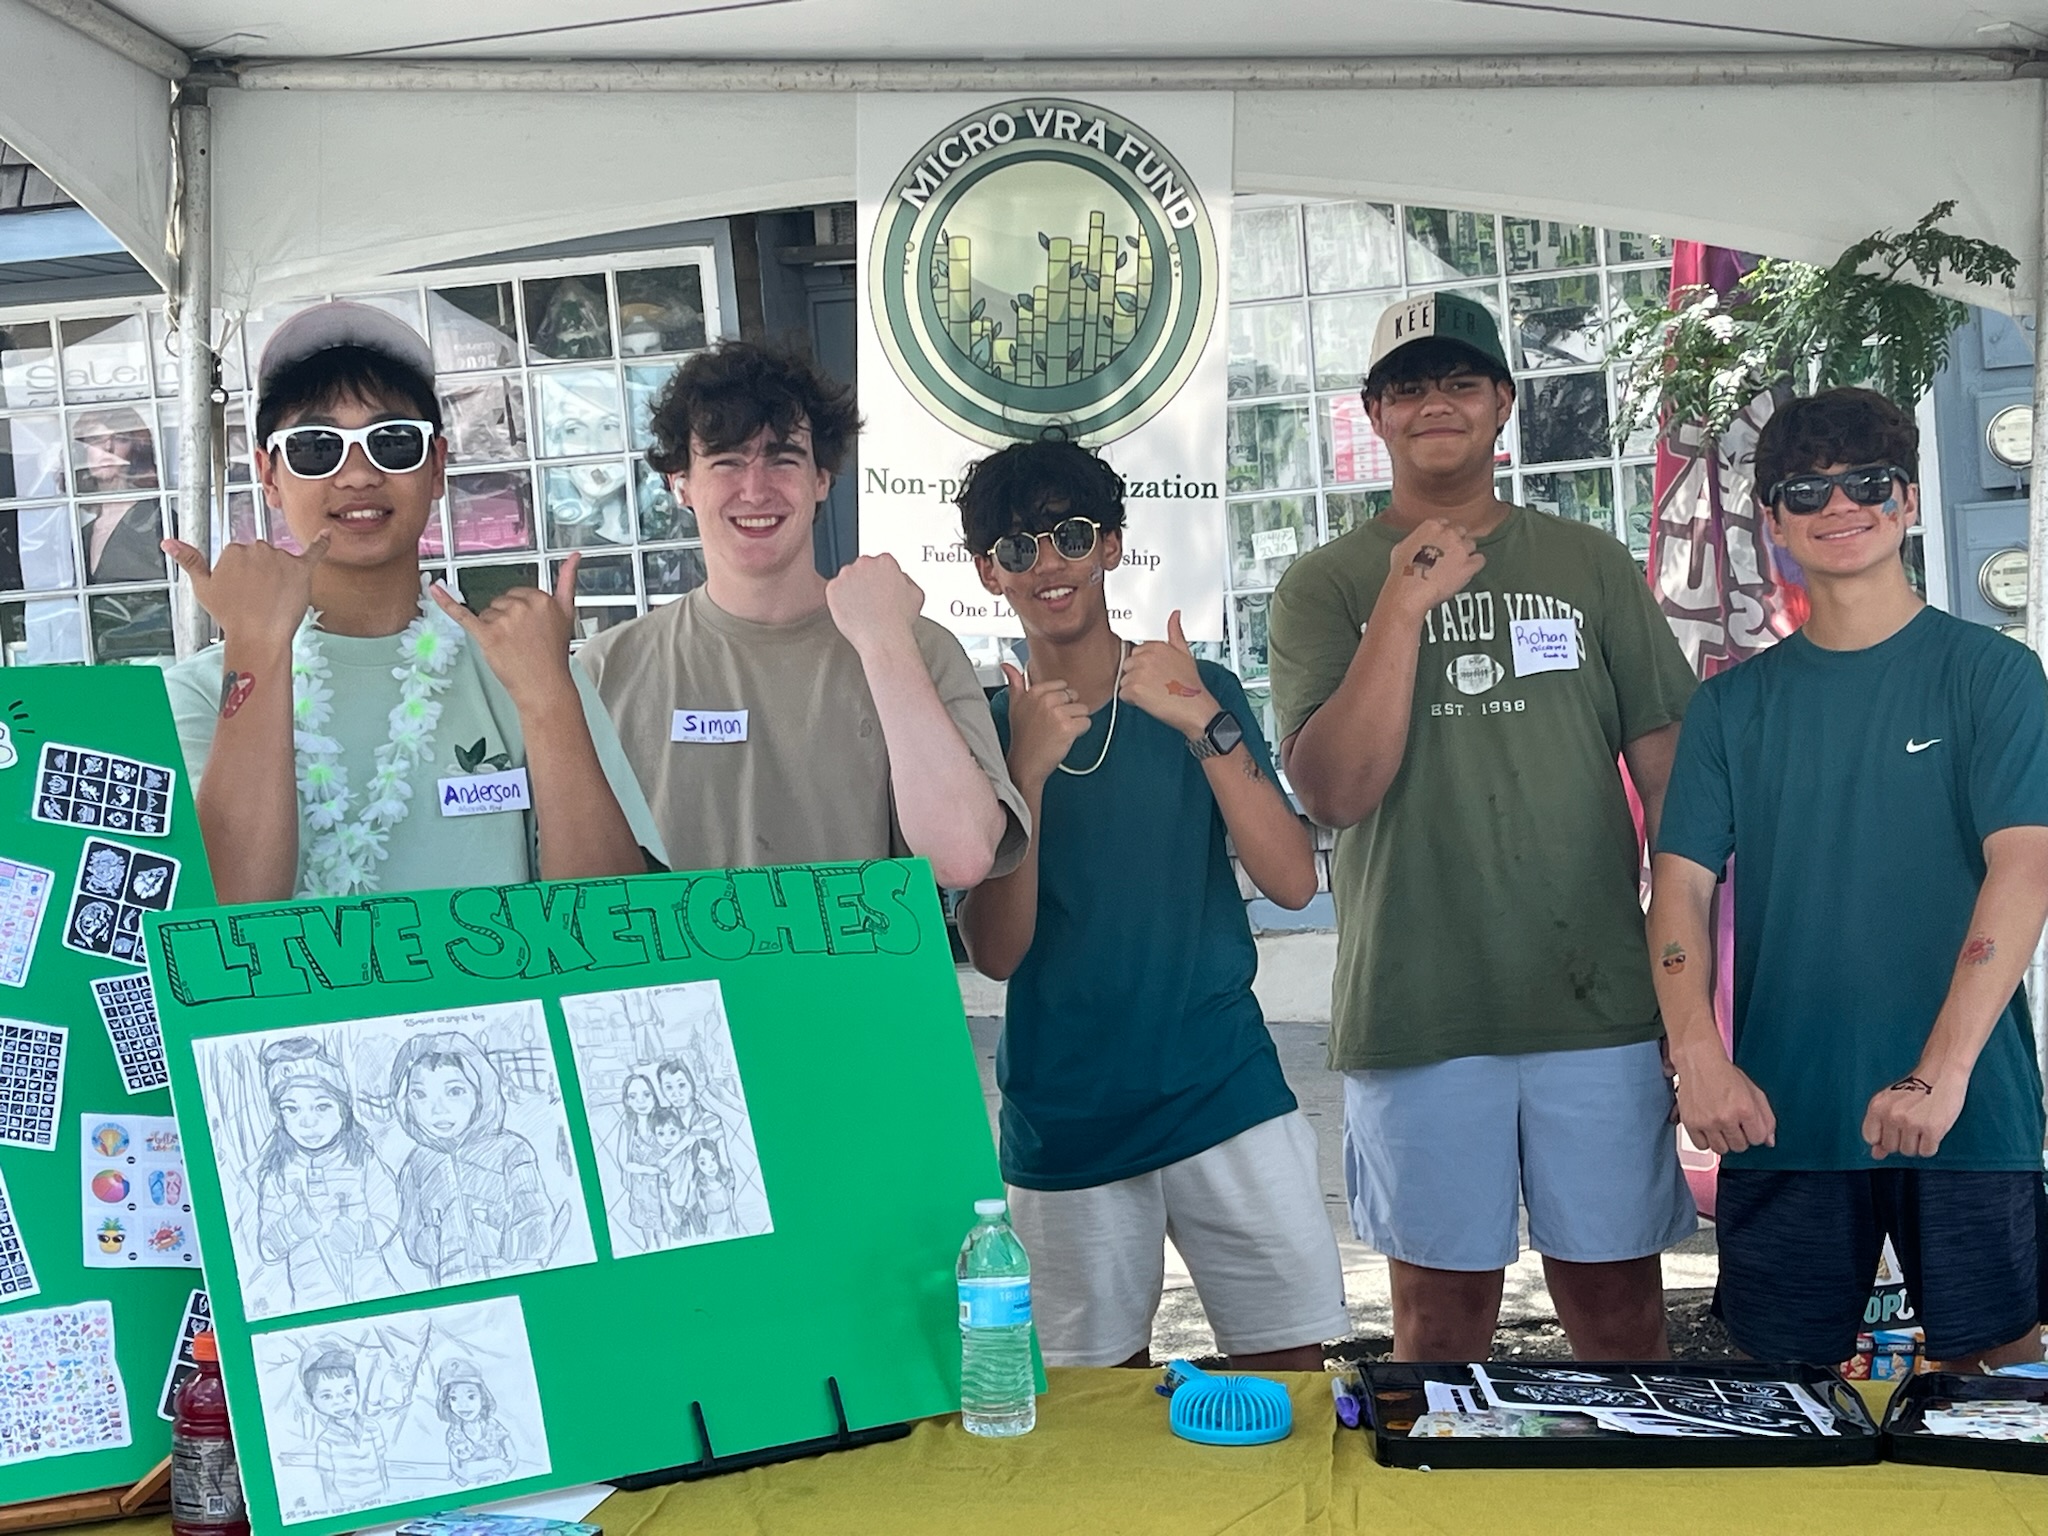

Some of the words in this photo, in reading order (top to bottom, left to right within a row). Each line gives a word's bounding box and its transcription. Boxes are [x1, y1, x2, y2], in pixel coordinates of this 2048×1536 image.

[900, 112, 1016, 211] MICRO
[1024, 108, 1109, 151] VRA
[1114, 133, 1198, 229] FUND
[865, 468, 958, 504] Non-p
[1121, 473, 1219, 499] ization
[950, 600, 987, 617] One
[994, 601, 1017, 617] Lo
[1515, 626, 1568, 646] Rohan
[683, 715, 741, 734] Simon
[444, 783, 521, 806] Anderson
[158, 897, 434, 1006] LIVE
[445, 858, 921, 979] SKETCHES
